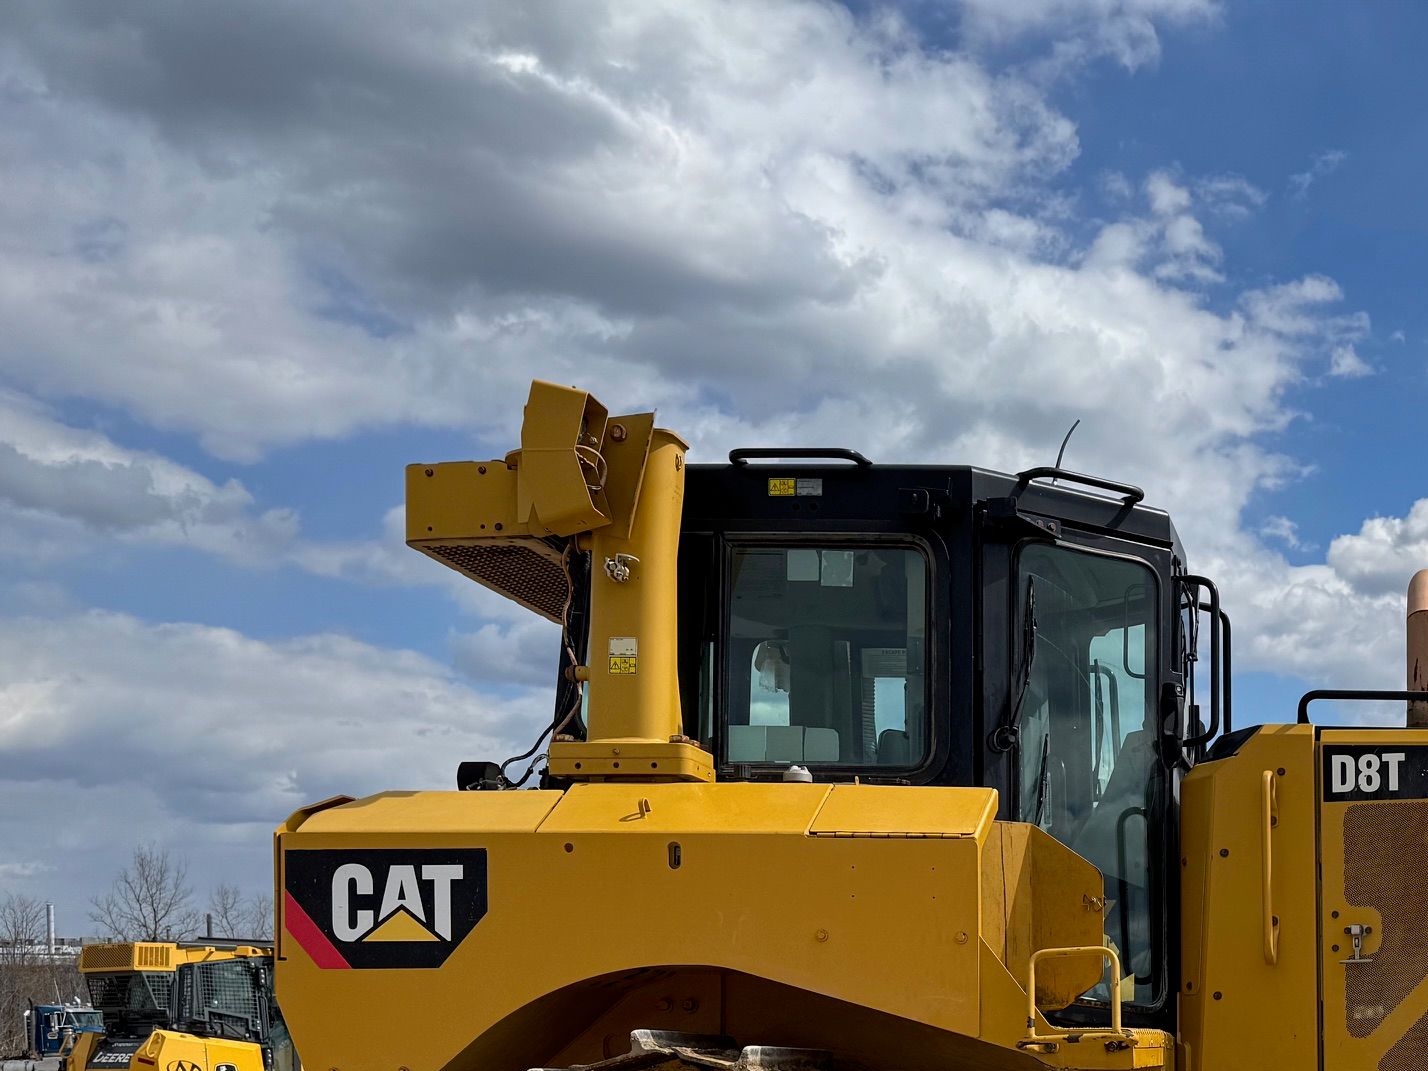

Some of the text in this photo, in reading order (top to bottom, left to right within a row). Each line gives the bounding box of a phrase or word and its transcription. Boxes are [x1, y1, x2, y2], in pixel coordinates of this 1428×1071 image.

[1331, 753, 1405, 794] D8T
[332, 863, 463, 942] CAT
[92, 1051, 134, 1063] DEERE
